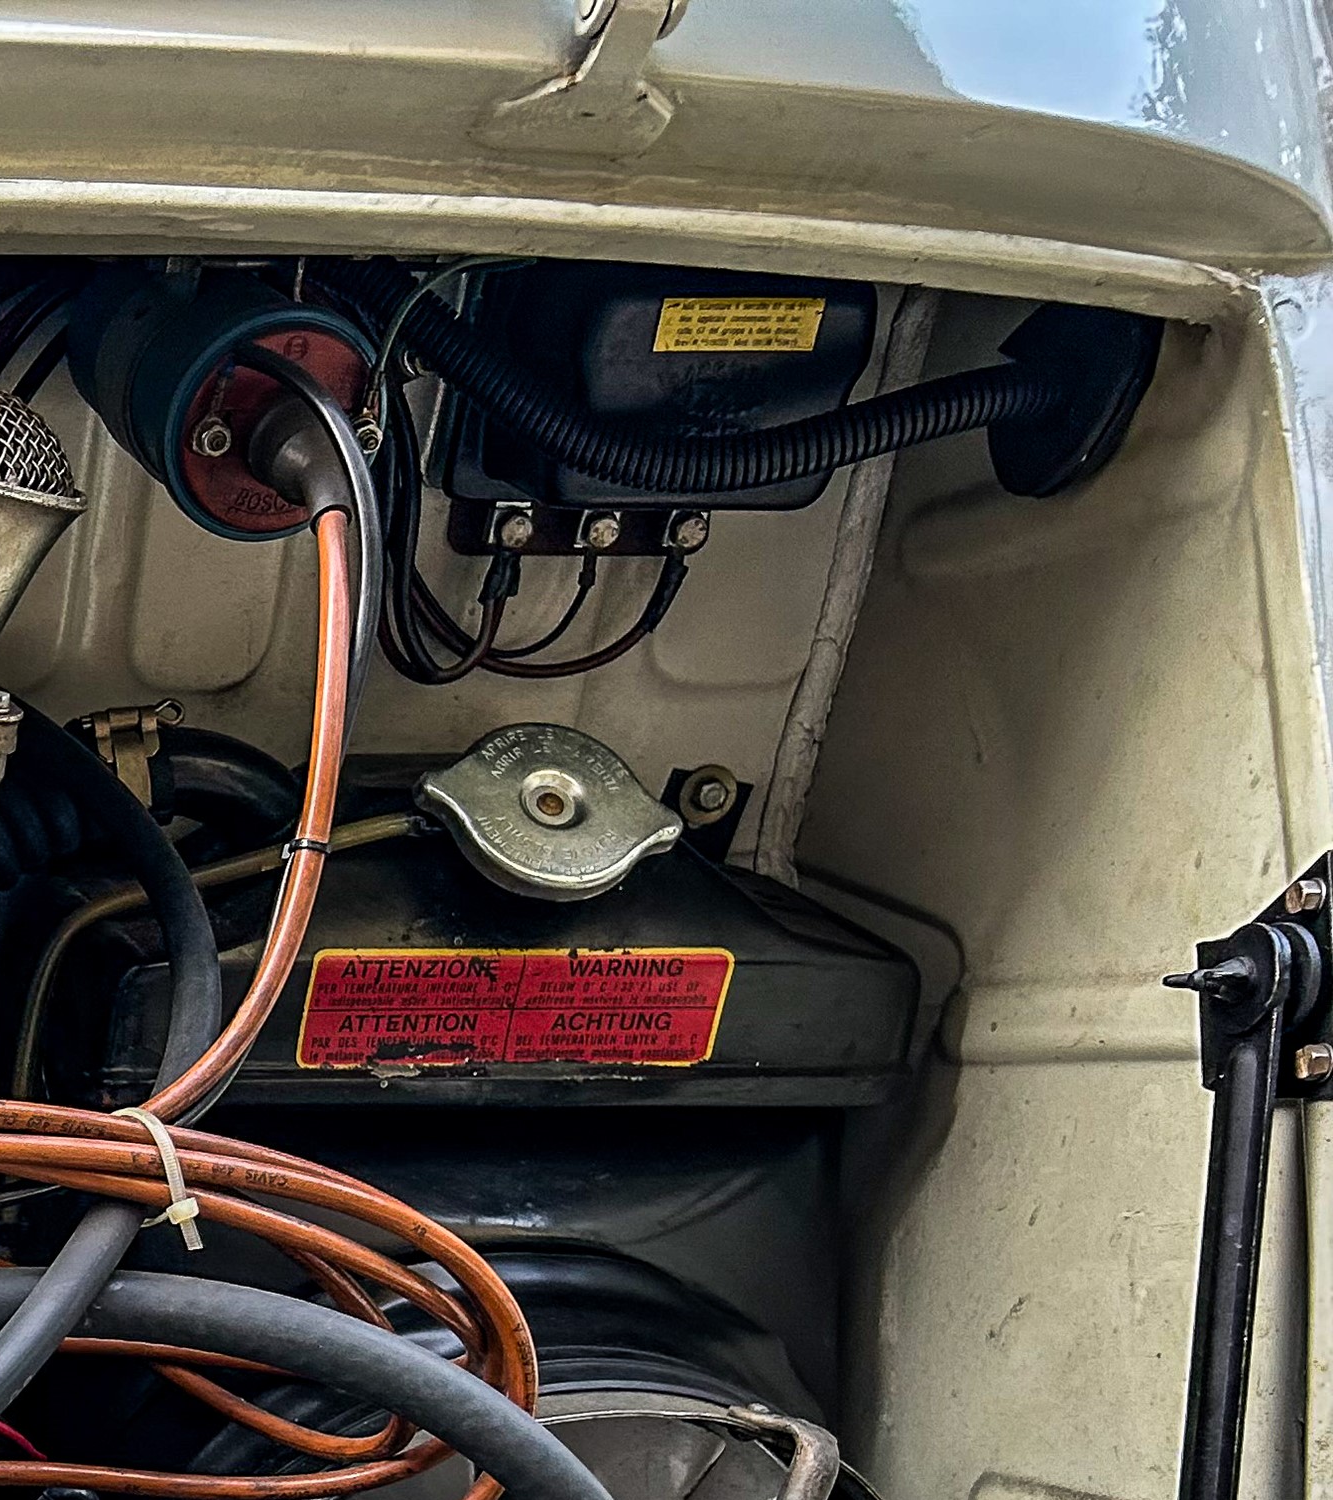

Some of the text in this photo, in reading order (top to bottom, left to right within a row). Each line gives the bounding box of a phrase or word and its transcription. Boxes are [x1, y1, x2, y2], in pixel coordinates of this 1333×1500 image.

[235, 488, 295, 511] BOSC
[481, 728, 527, 761] APRIRE
[341, 959, 501, 980] ATTENZIONE
[569, 958, 685, 977] WARNING
[317, 983, 337, 994] PER
[344, 982, 418, 994] TEMPERATURA
[426, 982, 479, 993] INFERIORE
[539, 981, 576, 993] BELOW
[339, 1013, 479, 1033] ATTENTION
[551, 1012, 673, 1031] ACHTUNG
[311, 1036, 330, 1048] PAR
[338, 1036, 357, 1047] DES
[624, 1034, 658, 1046] UNTER
[244, 1168, 288, 1187] CAVIS
